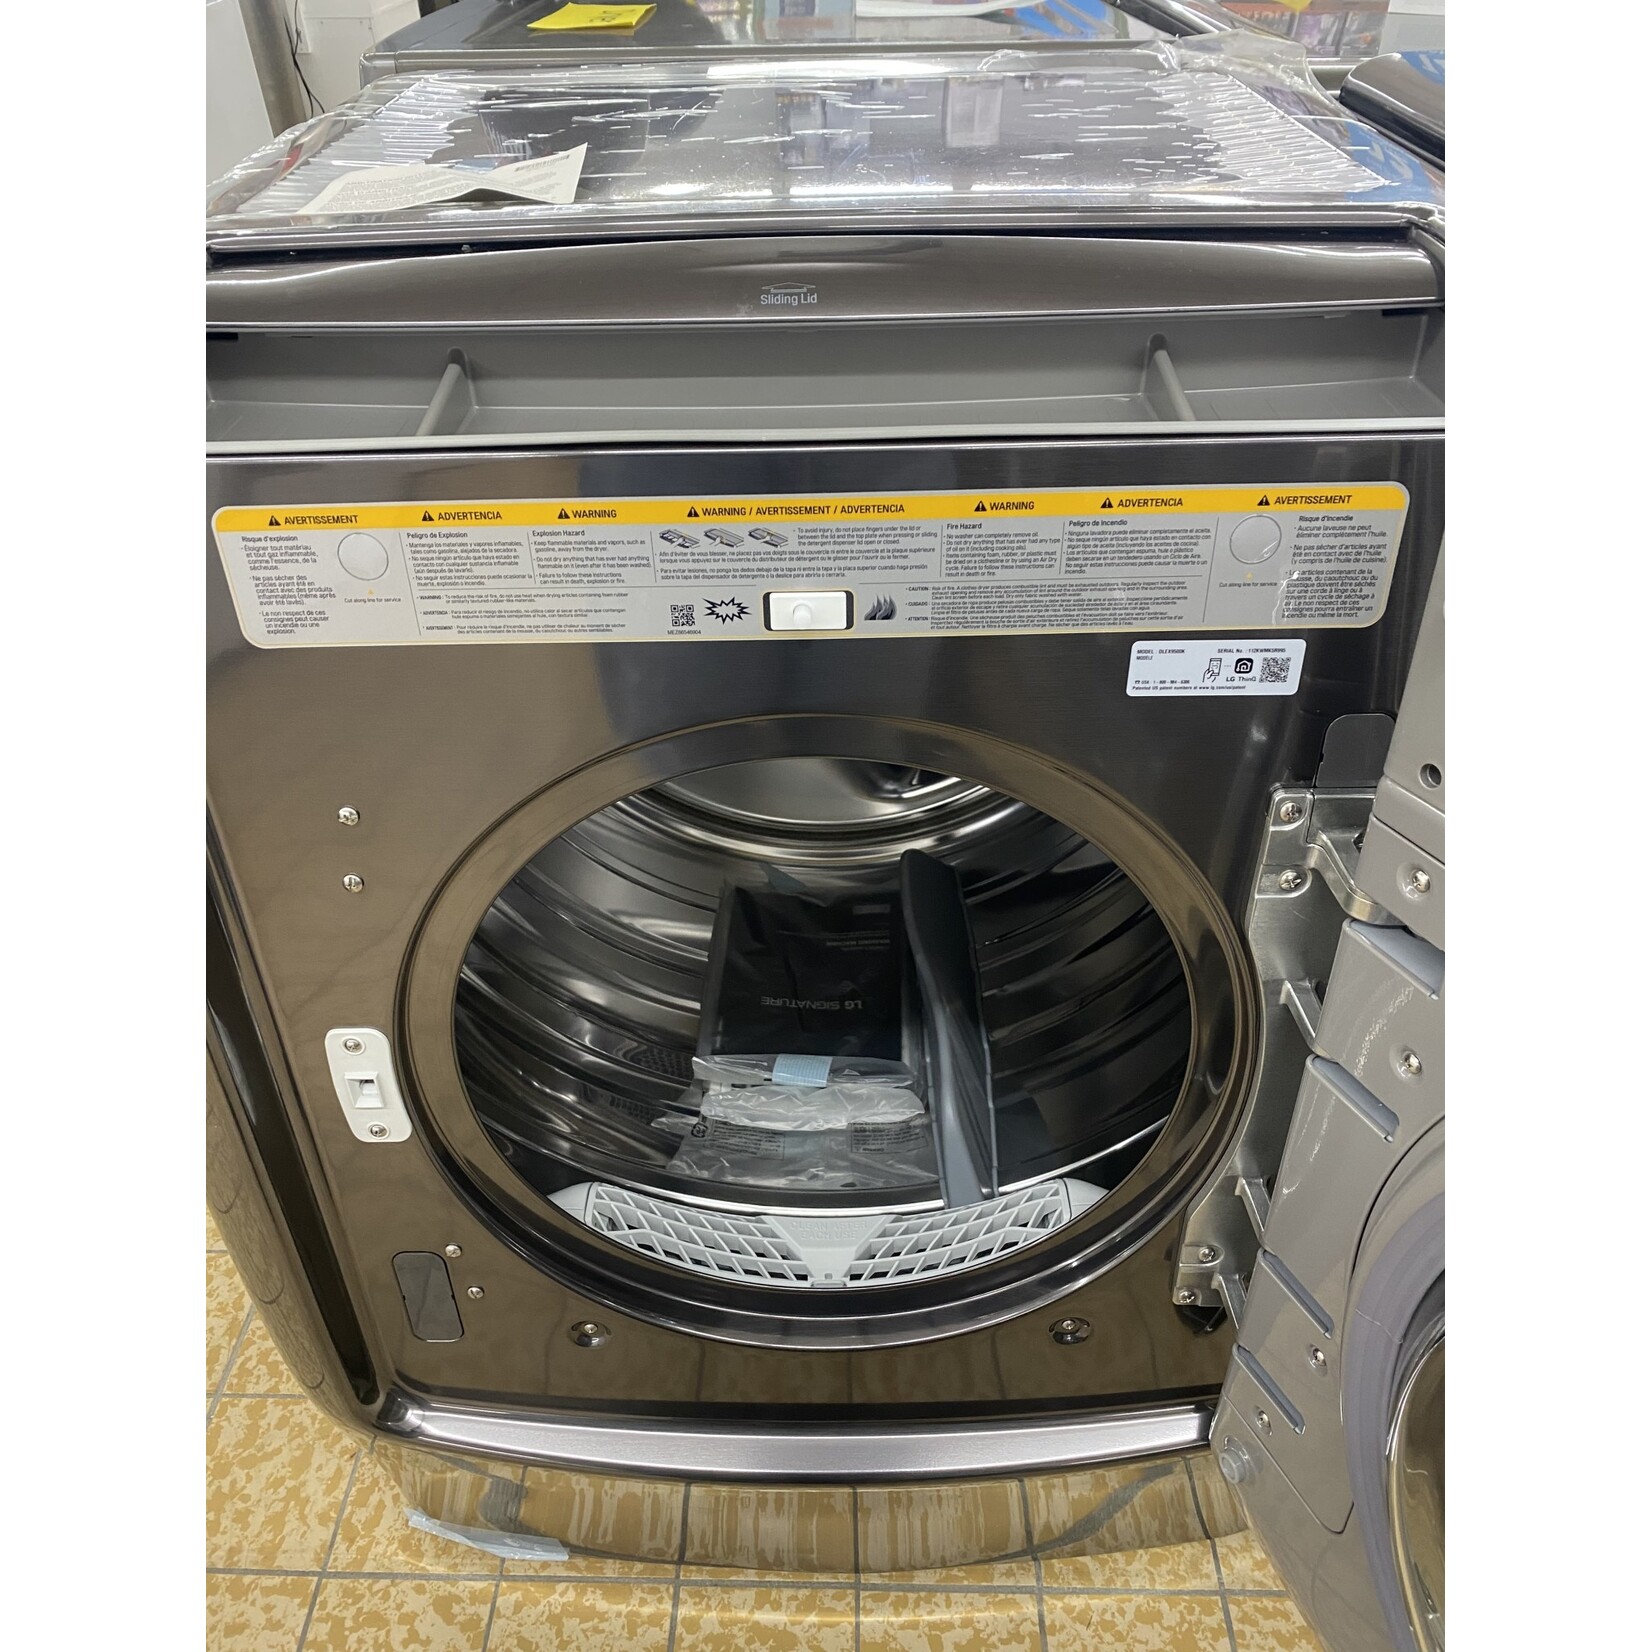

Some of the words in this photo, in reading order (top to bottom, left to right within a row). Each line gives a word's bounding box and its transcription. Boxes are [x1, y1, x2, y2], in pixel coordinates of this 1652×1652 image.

[760, 294, 798, 306] Sliding
[801, 293, 817, 303] Lid
[1117, 498, 1183, 508] ADVERTENCIA
[1274, 495, 1352, 504] AVERTISSEMENT
[702, 507, 746, 516] WARNING
[749, 507, 752, 515] /
[756, 506, 831, 515] AVERTISSEMENT
[834, 506, 837, 514] /
[840, 504, 904, 514] ADVERTENCIA
[990, 501, 1034, 510] WARNING
[438, 511, 502, 520] ADVERTENCIA
[572, 510, 617, 518] WARNING
[284, 515, 358, 524] AVERTISSEMENT
[760, 996, 840, 1010] SIGNATURE
[844, 1000, 863, 1010] LG
